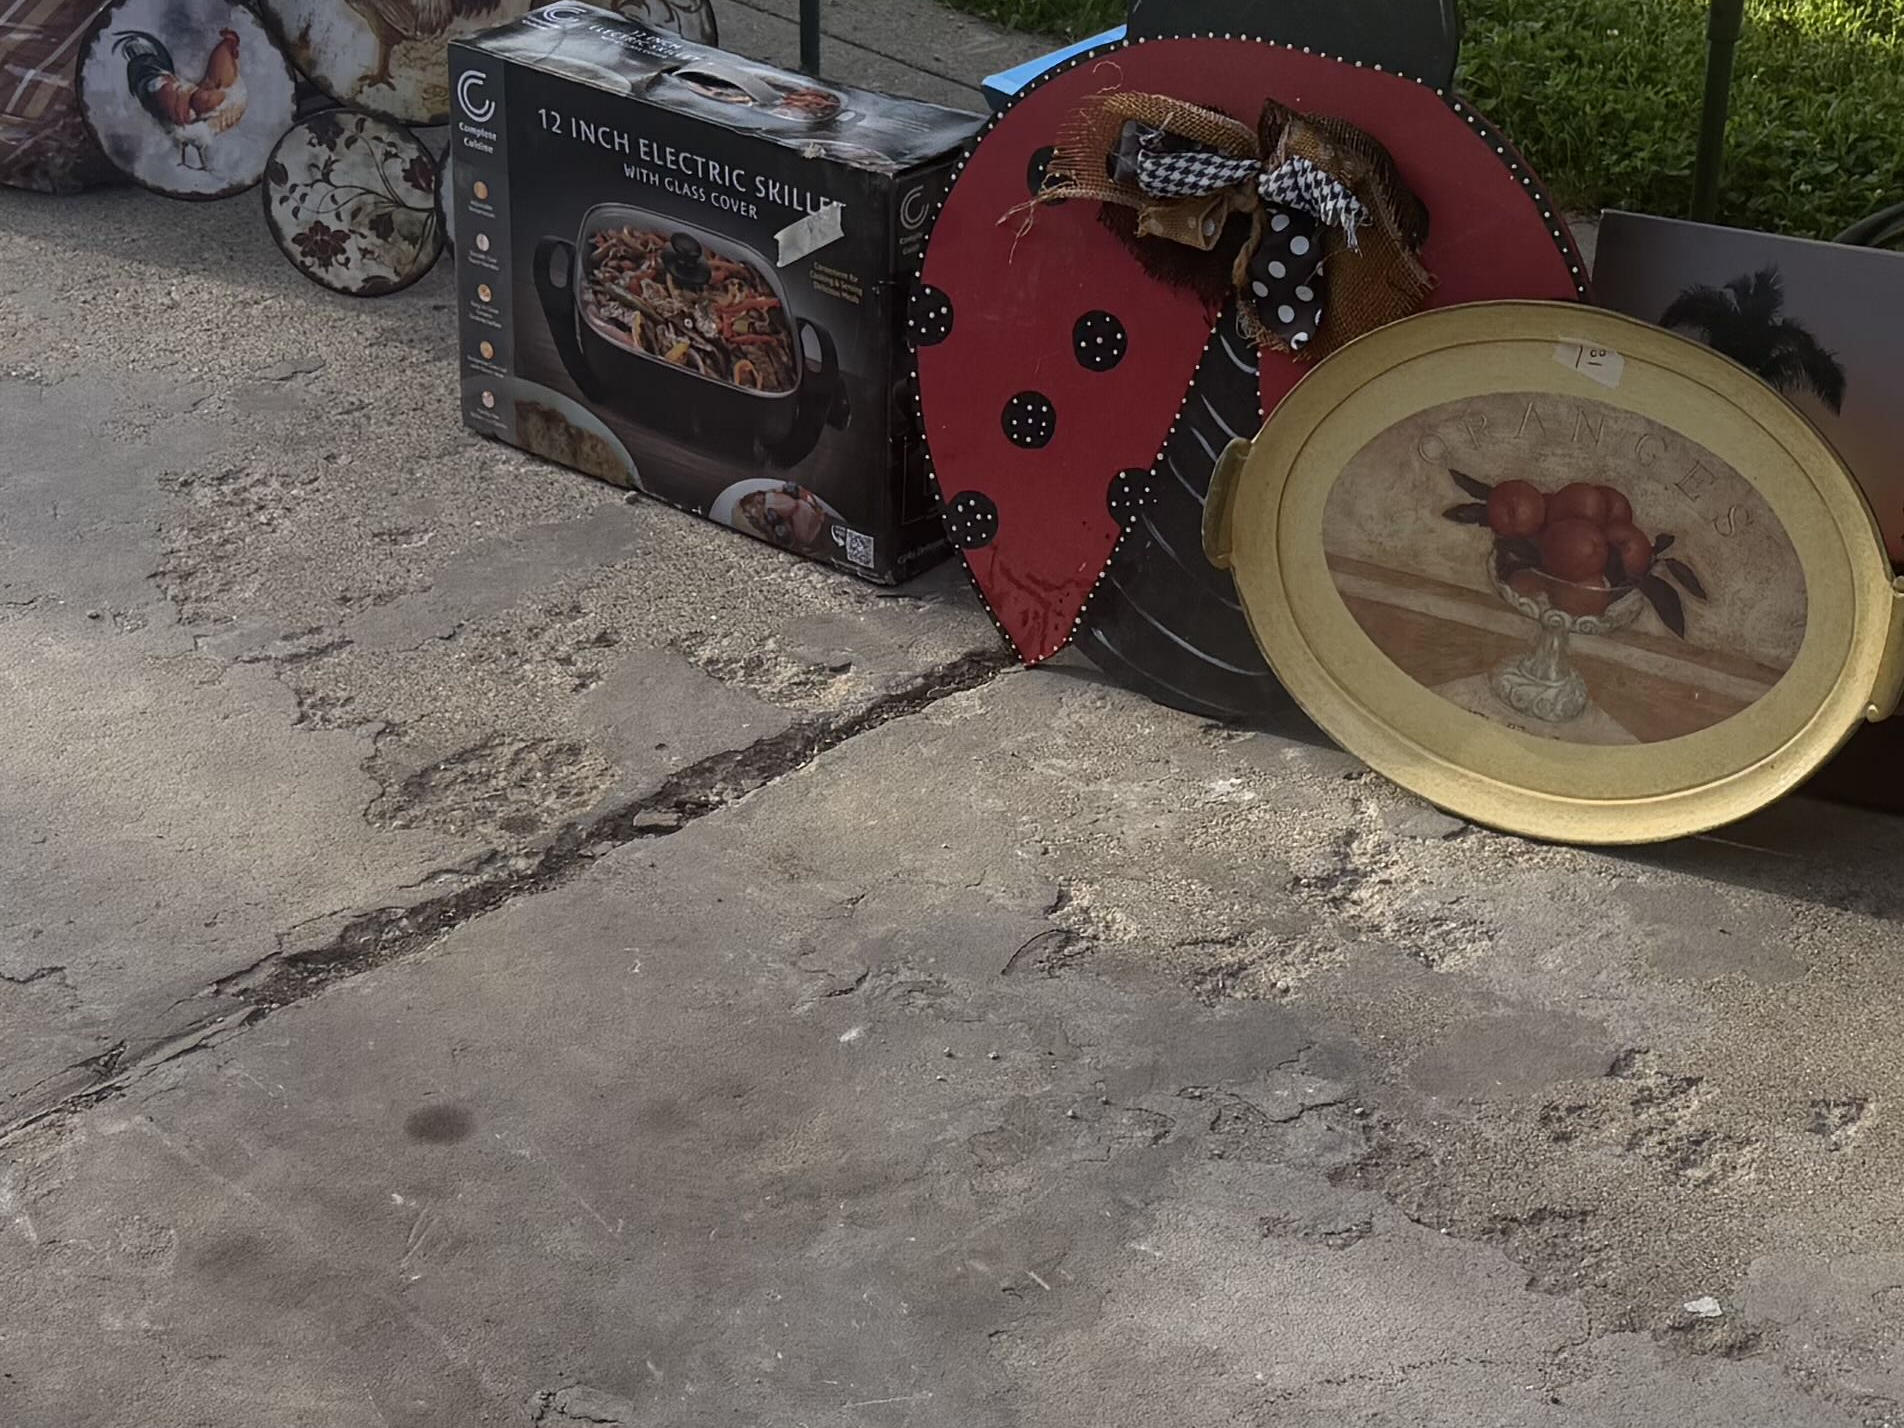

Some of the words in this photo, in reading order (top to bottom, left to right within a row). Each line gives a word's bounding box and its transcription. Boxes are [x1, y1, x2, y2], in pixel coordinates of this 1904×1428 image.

[463, 137, 494, 154] Cuisine
[538, 108, 563, 135] 12
[570, 117, 630, 154] INCH
[638, 138, 747, 193] ELECTRIC
[623, 163, 660, 187] WITH
[664, 176, 707, 202] GLASS
[711, 192, 758, 220] COVER
[1416, 401, 1756, 539] ORANGES
